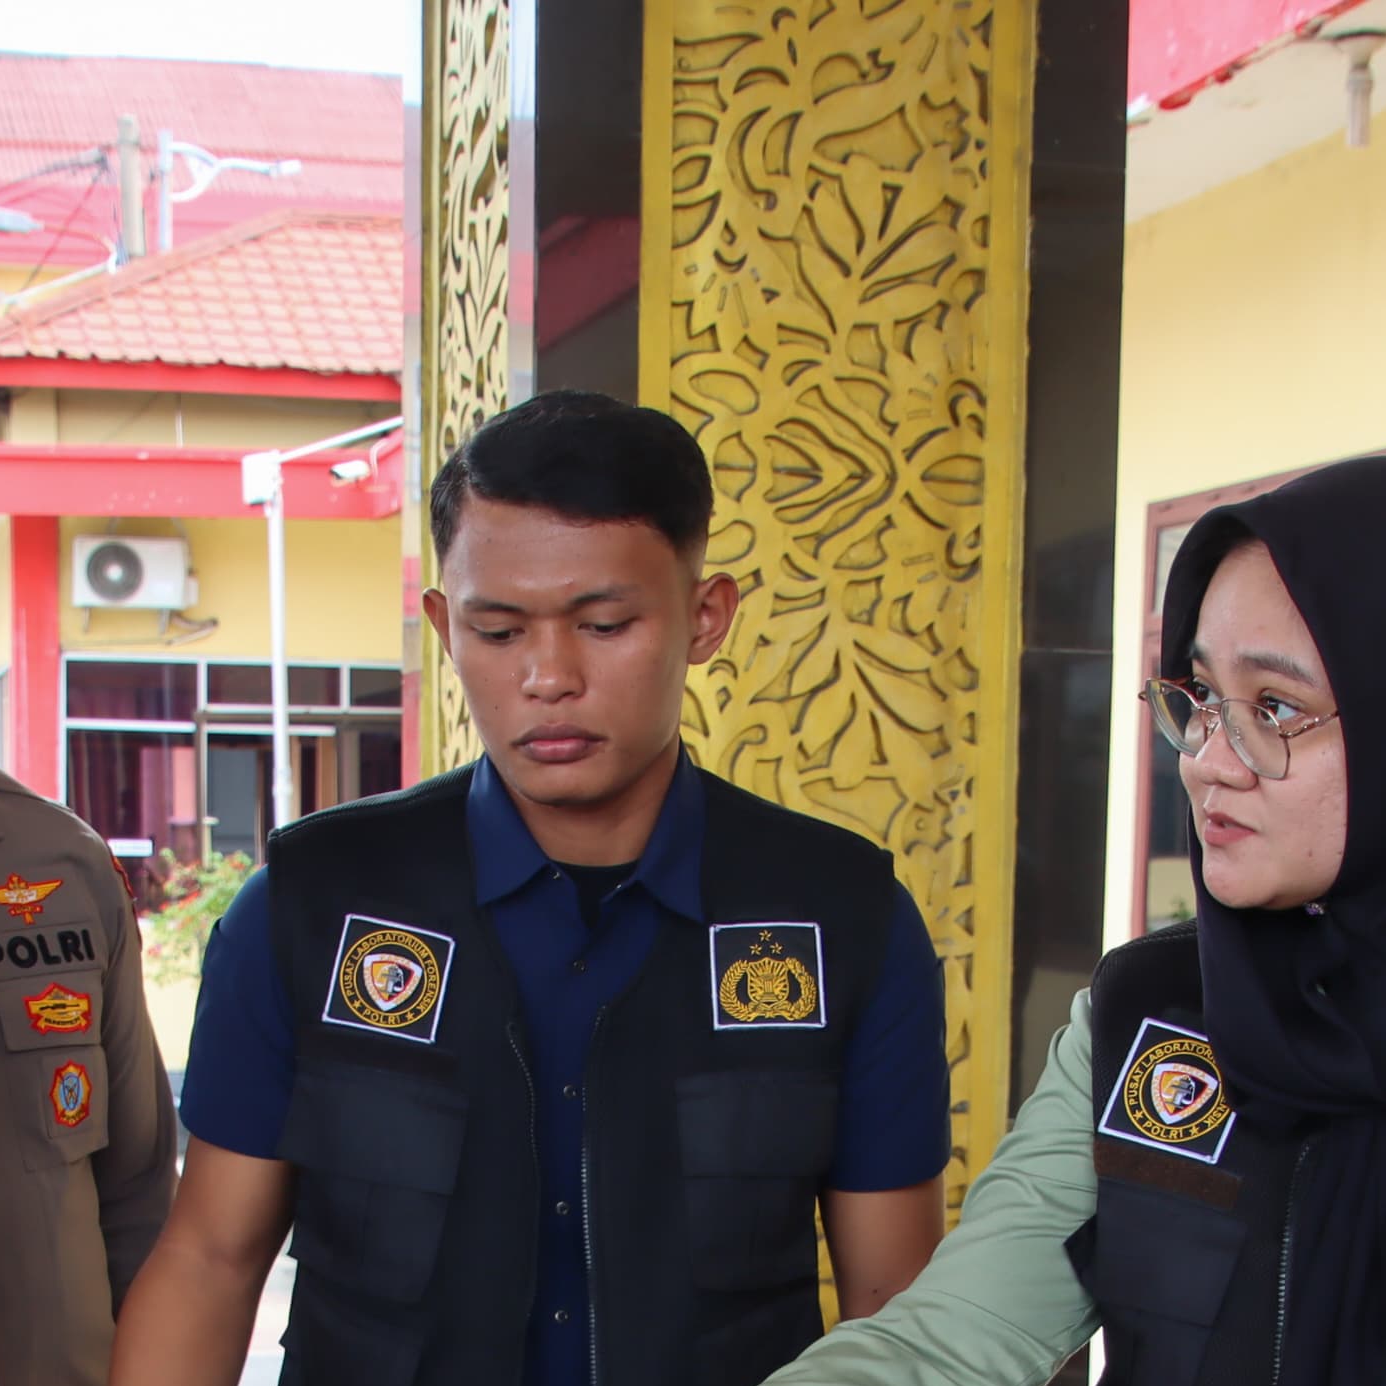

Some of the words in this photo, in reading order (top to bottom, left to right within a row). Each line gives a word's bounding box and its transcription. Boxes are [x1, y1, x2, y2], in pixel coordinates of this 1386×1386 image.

[344, 962, 356, 998] PUSAT
[353, 932, 429, 961] LABORATORIUM
[416, 958, 436, 1013] FORENSIK
[363, 1007, 401, 1025] POLRI
[1129, 1069, 1144, 1105] PUSAT
[1142, 1042, 1215, 1067] LABORATOR
[1142, 1120, 1184, 1140] POLRI
